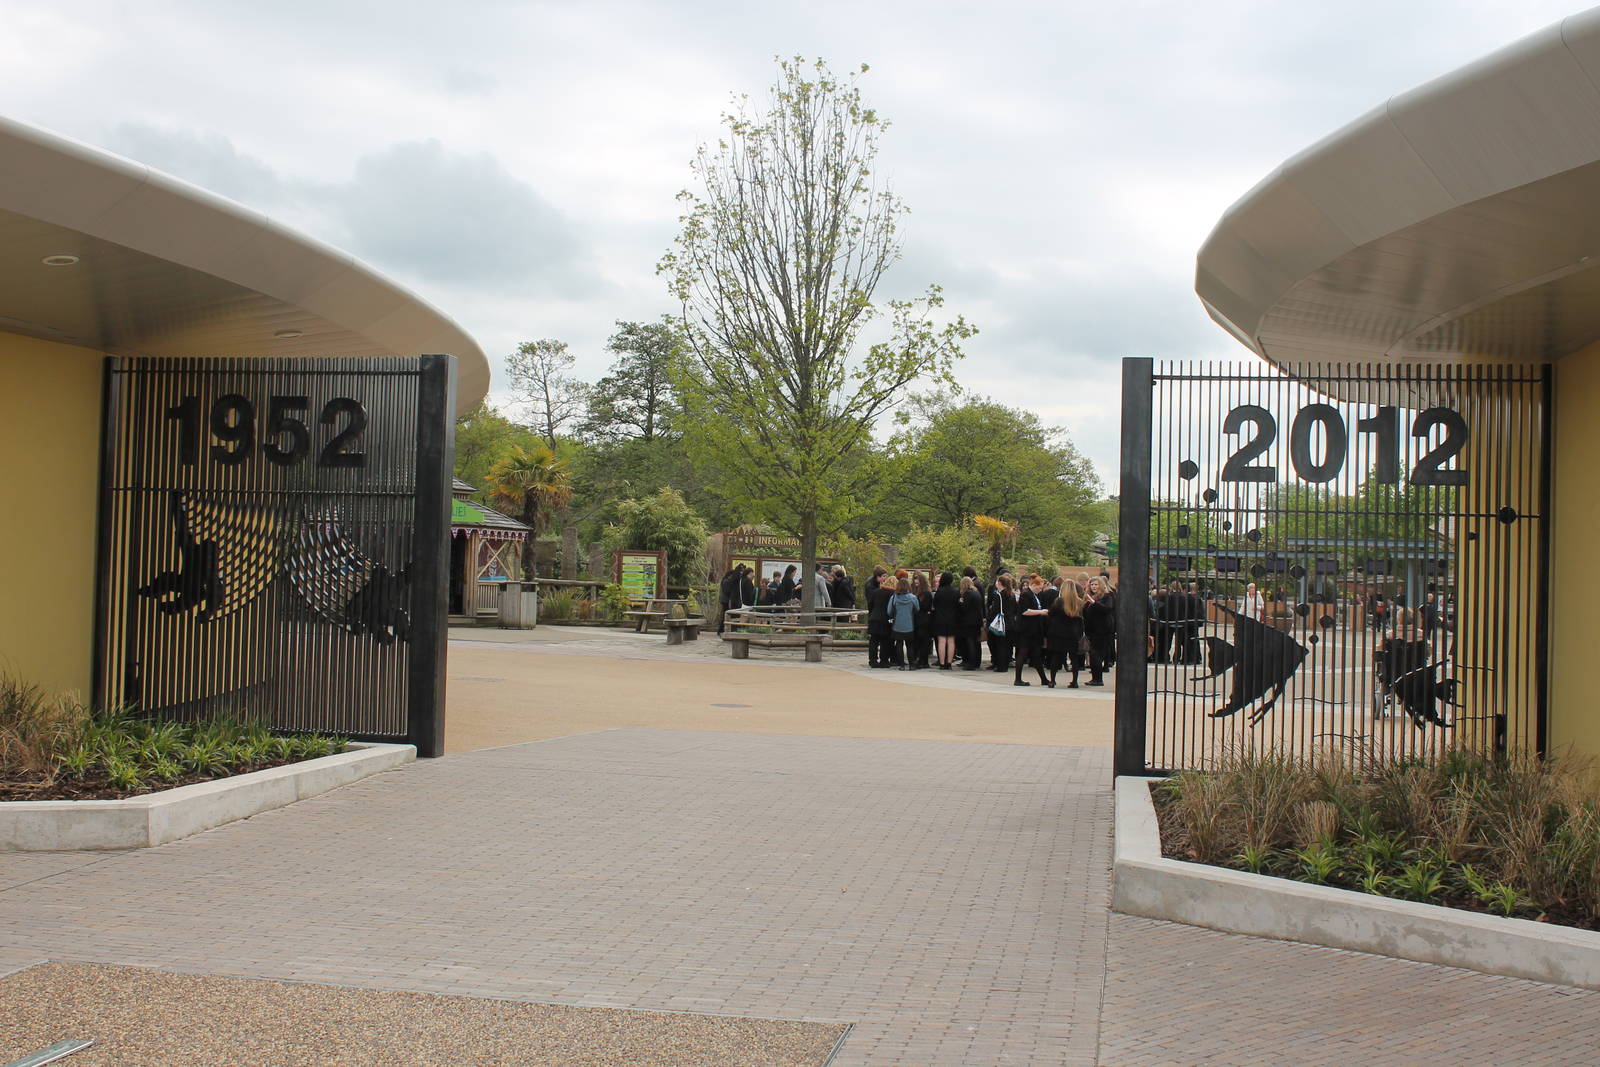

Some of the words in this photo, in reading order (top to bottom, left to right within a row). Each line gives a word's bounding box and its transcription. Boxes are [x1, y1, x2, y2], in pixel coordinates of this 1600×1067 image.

[167, 394, 368, 468] 1952
[1221, 403, 1468, 486] 2012
[759, 536, 801, 546] INFORMA
